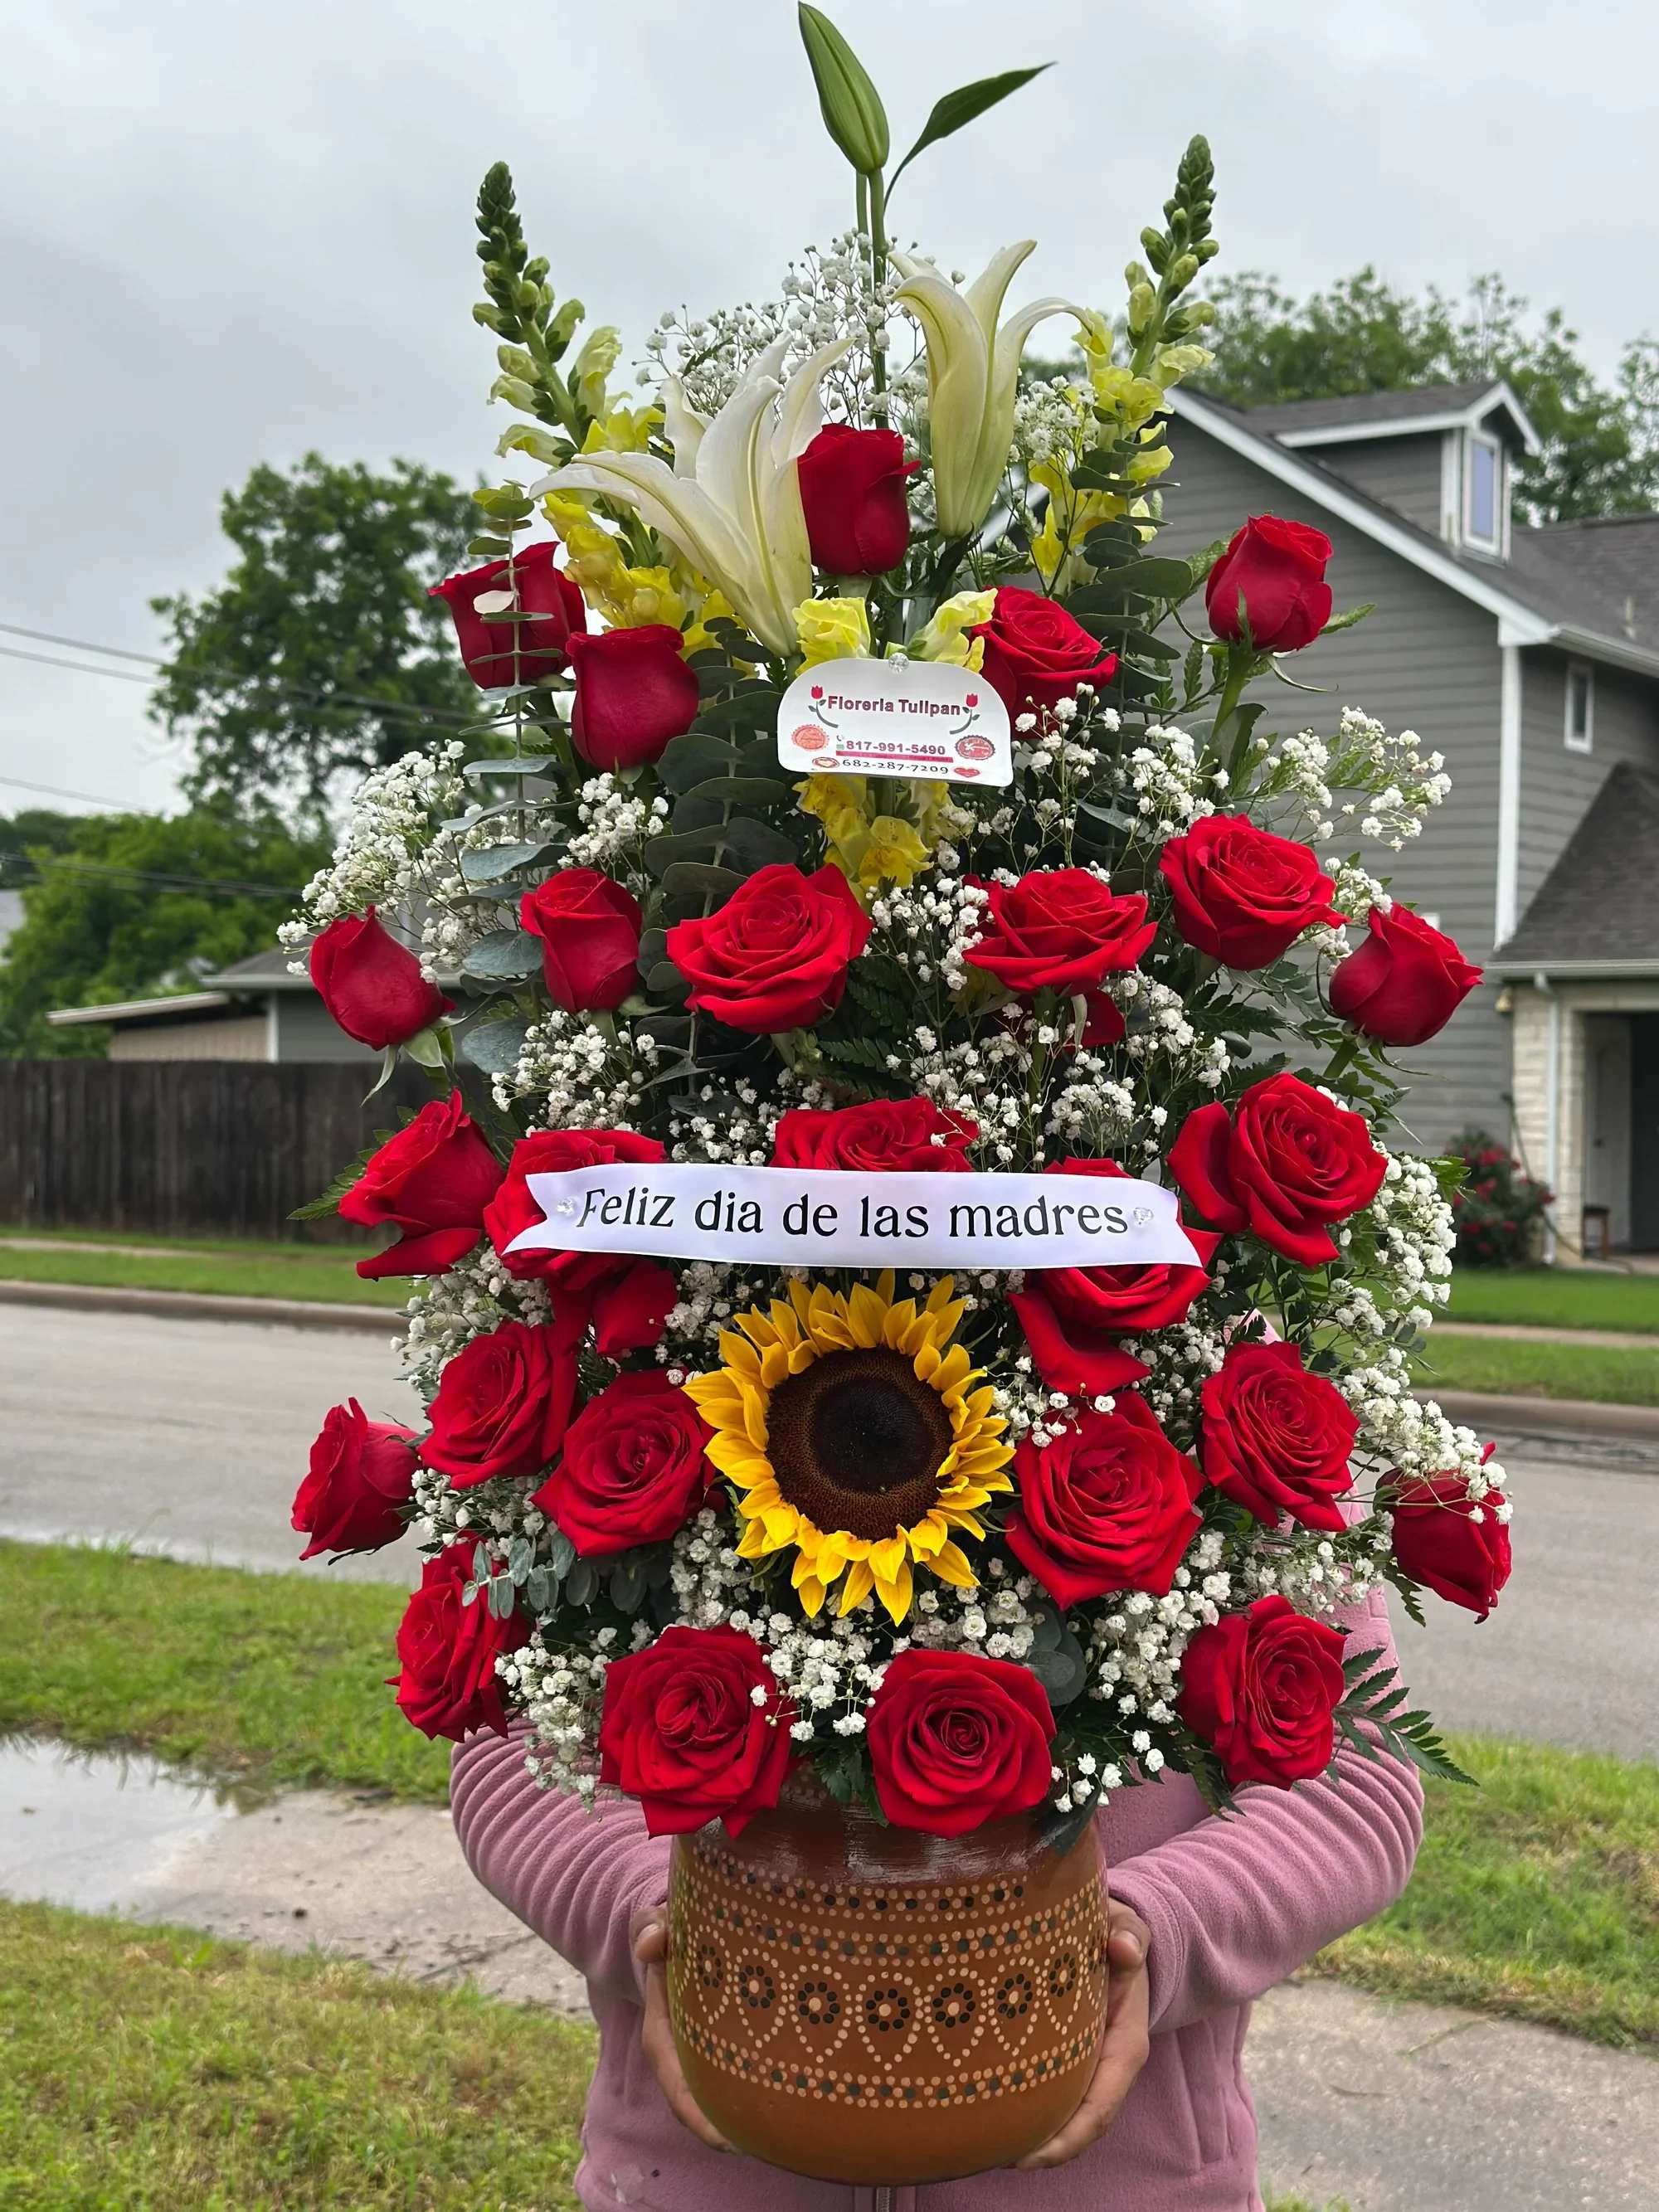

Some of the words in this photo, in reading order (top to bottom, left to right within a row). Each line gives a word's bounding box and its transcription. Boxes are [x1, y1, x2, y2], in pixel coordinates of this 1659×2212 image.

[898, 698, 961, 717] Tulipan
[845, 740, 946, 756] 817-991-5490
[842, 759, 949, 775] 682-287-7209
[576, 1186, 675, 1228] Feliz
[694, 1189, 763, 1233] dia
[782, 1193, 838, 1237] de
[859, 1195, 929, 1237] las
[949, 1194, 1128, 1237] madres
